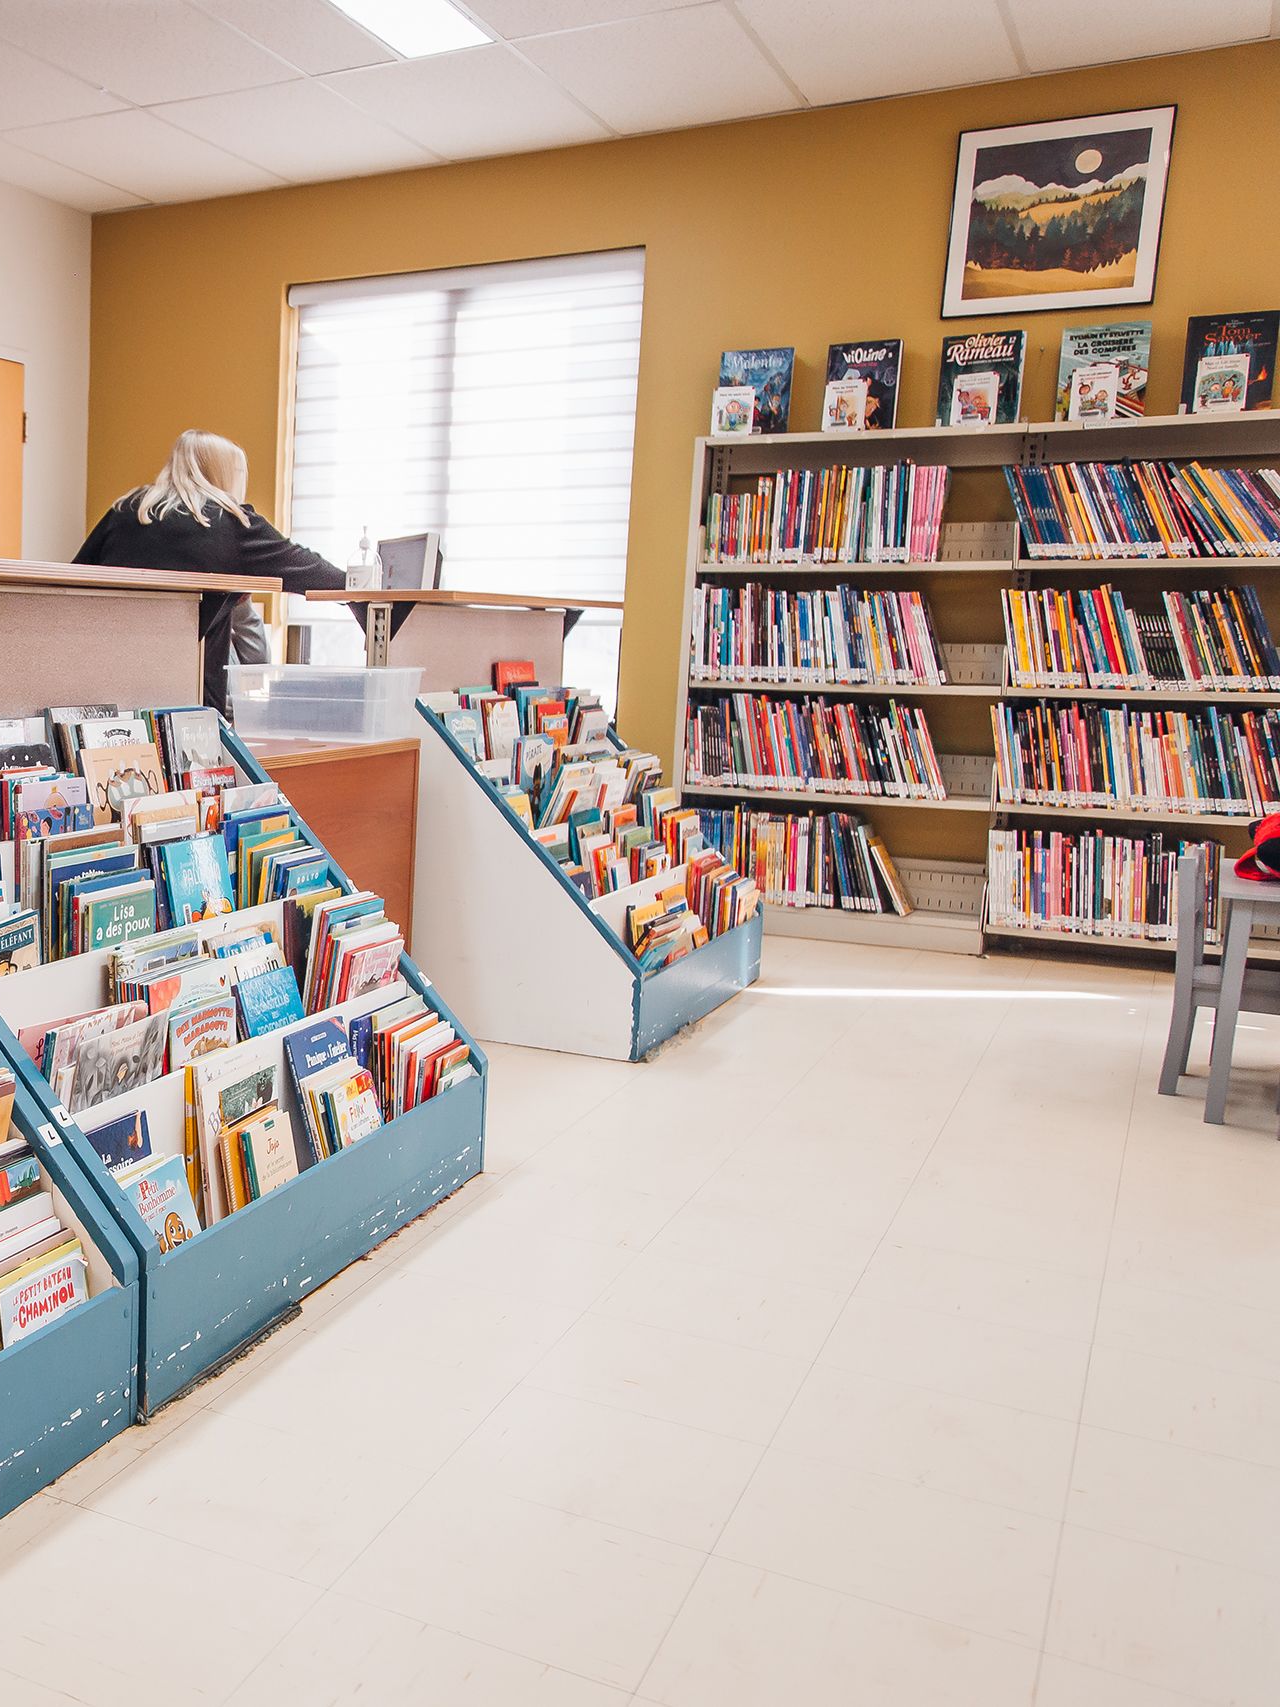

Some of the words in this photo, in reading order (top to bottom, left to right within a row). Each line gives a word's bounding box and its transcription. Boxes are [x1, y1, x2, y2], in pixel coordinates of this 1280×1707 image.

[965, 334, 1006, 349] Olivier
[946, 343, 1014, 366] Rameau
[113, 904, 135, 921] Lisa
[96, 927, 103, 941] a
[106, 921, 123, 938] des
[125, 916, 151, 941] poux
[0, 929, 33, 950] ÉLÉFANT
[59, 1111, 67, 1121] L
[47, 1129, 56, 1140] L
[101, 1153, 112, 1165] La
[138, 1186, 177, 1216] Bonhomme
[139, 1180, 159, 1201] Petit
[19, 1281, 41, 1304] PETIT
[43, 1266, 73, 1291] BATEAU
[18, 1282, 75, 1328] CHAMINOU
